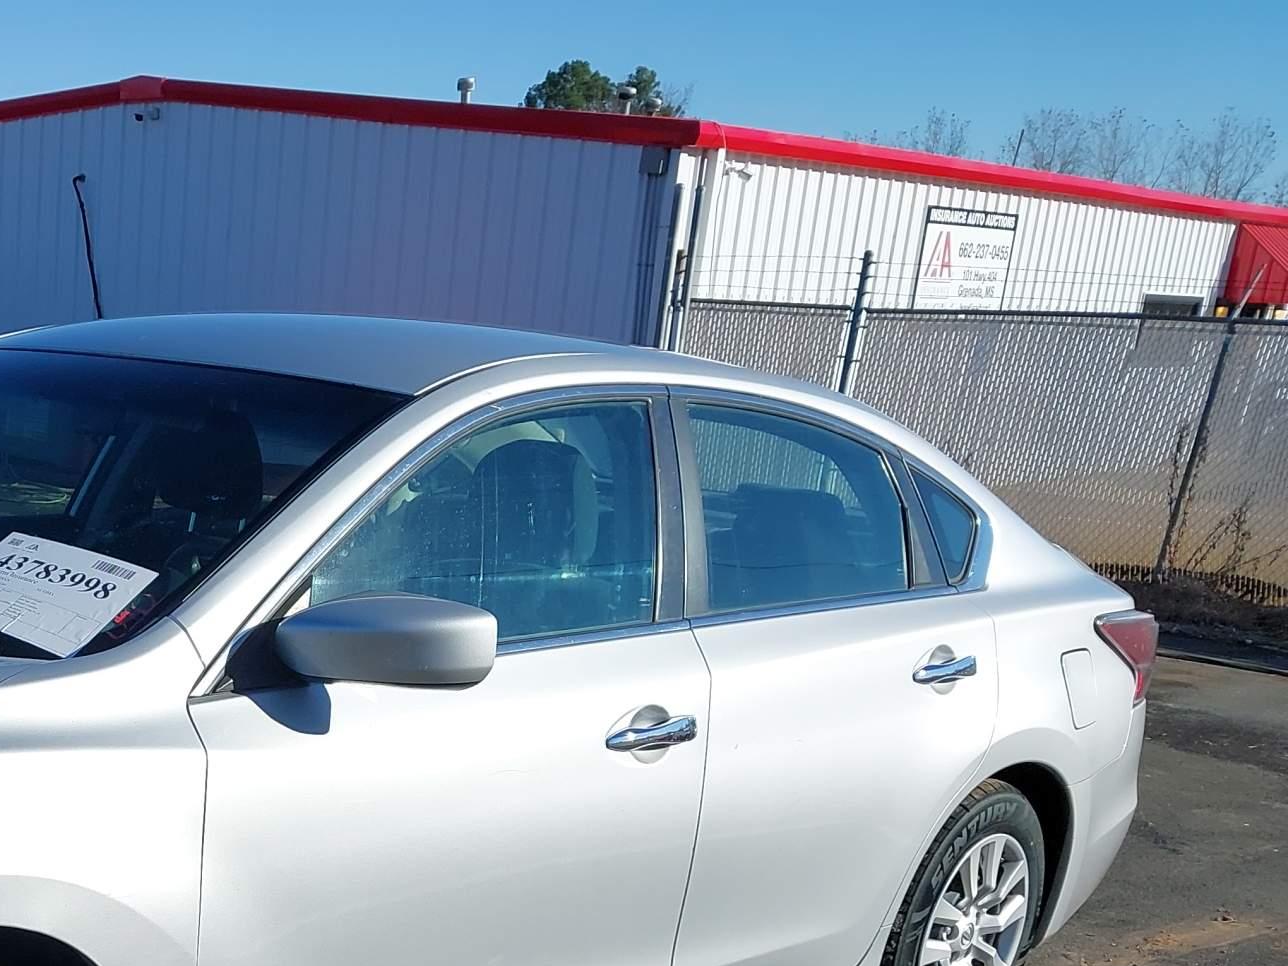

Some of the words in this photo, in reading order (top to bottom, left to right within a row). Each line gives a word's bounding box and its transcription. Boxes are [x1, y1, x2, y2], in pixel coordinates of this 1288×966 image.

[930, 208, 968, 224] INSURANCE
[968, 212, 985, 226] AUTO
[985, 214, 1016, 229] AUCTIONS
[9, 571, 39, 585] Insurance
[930, 799, 1019, 890] SENTURY
